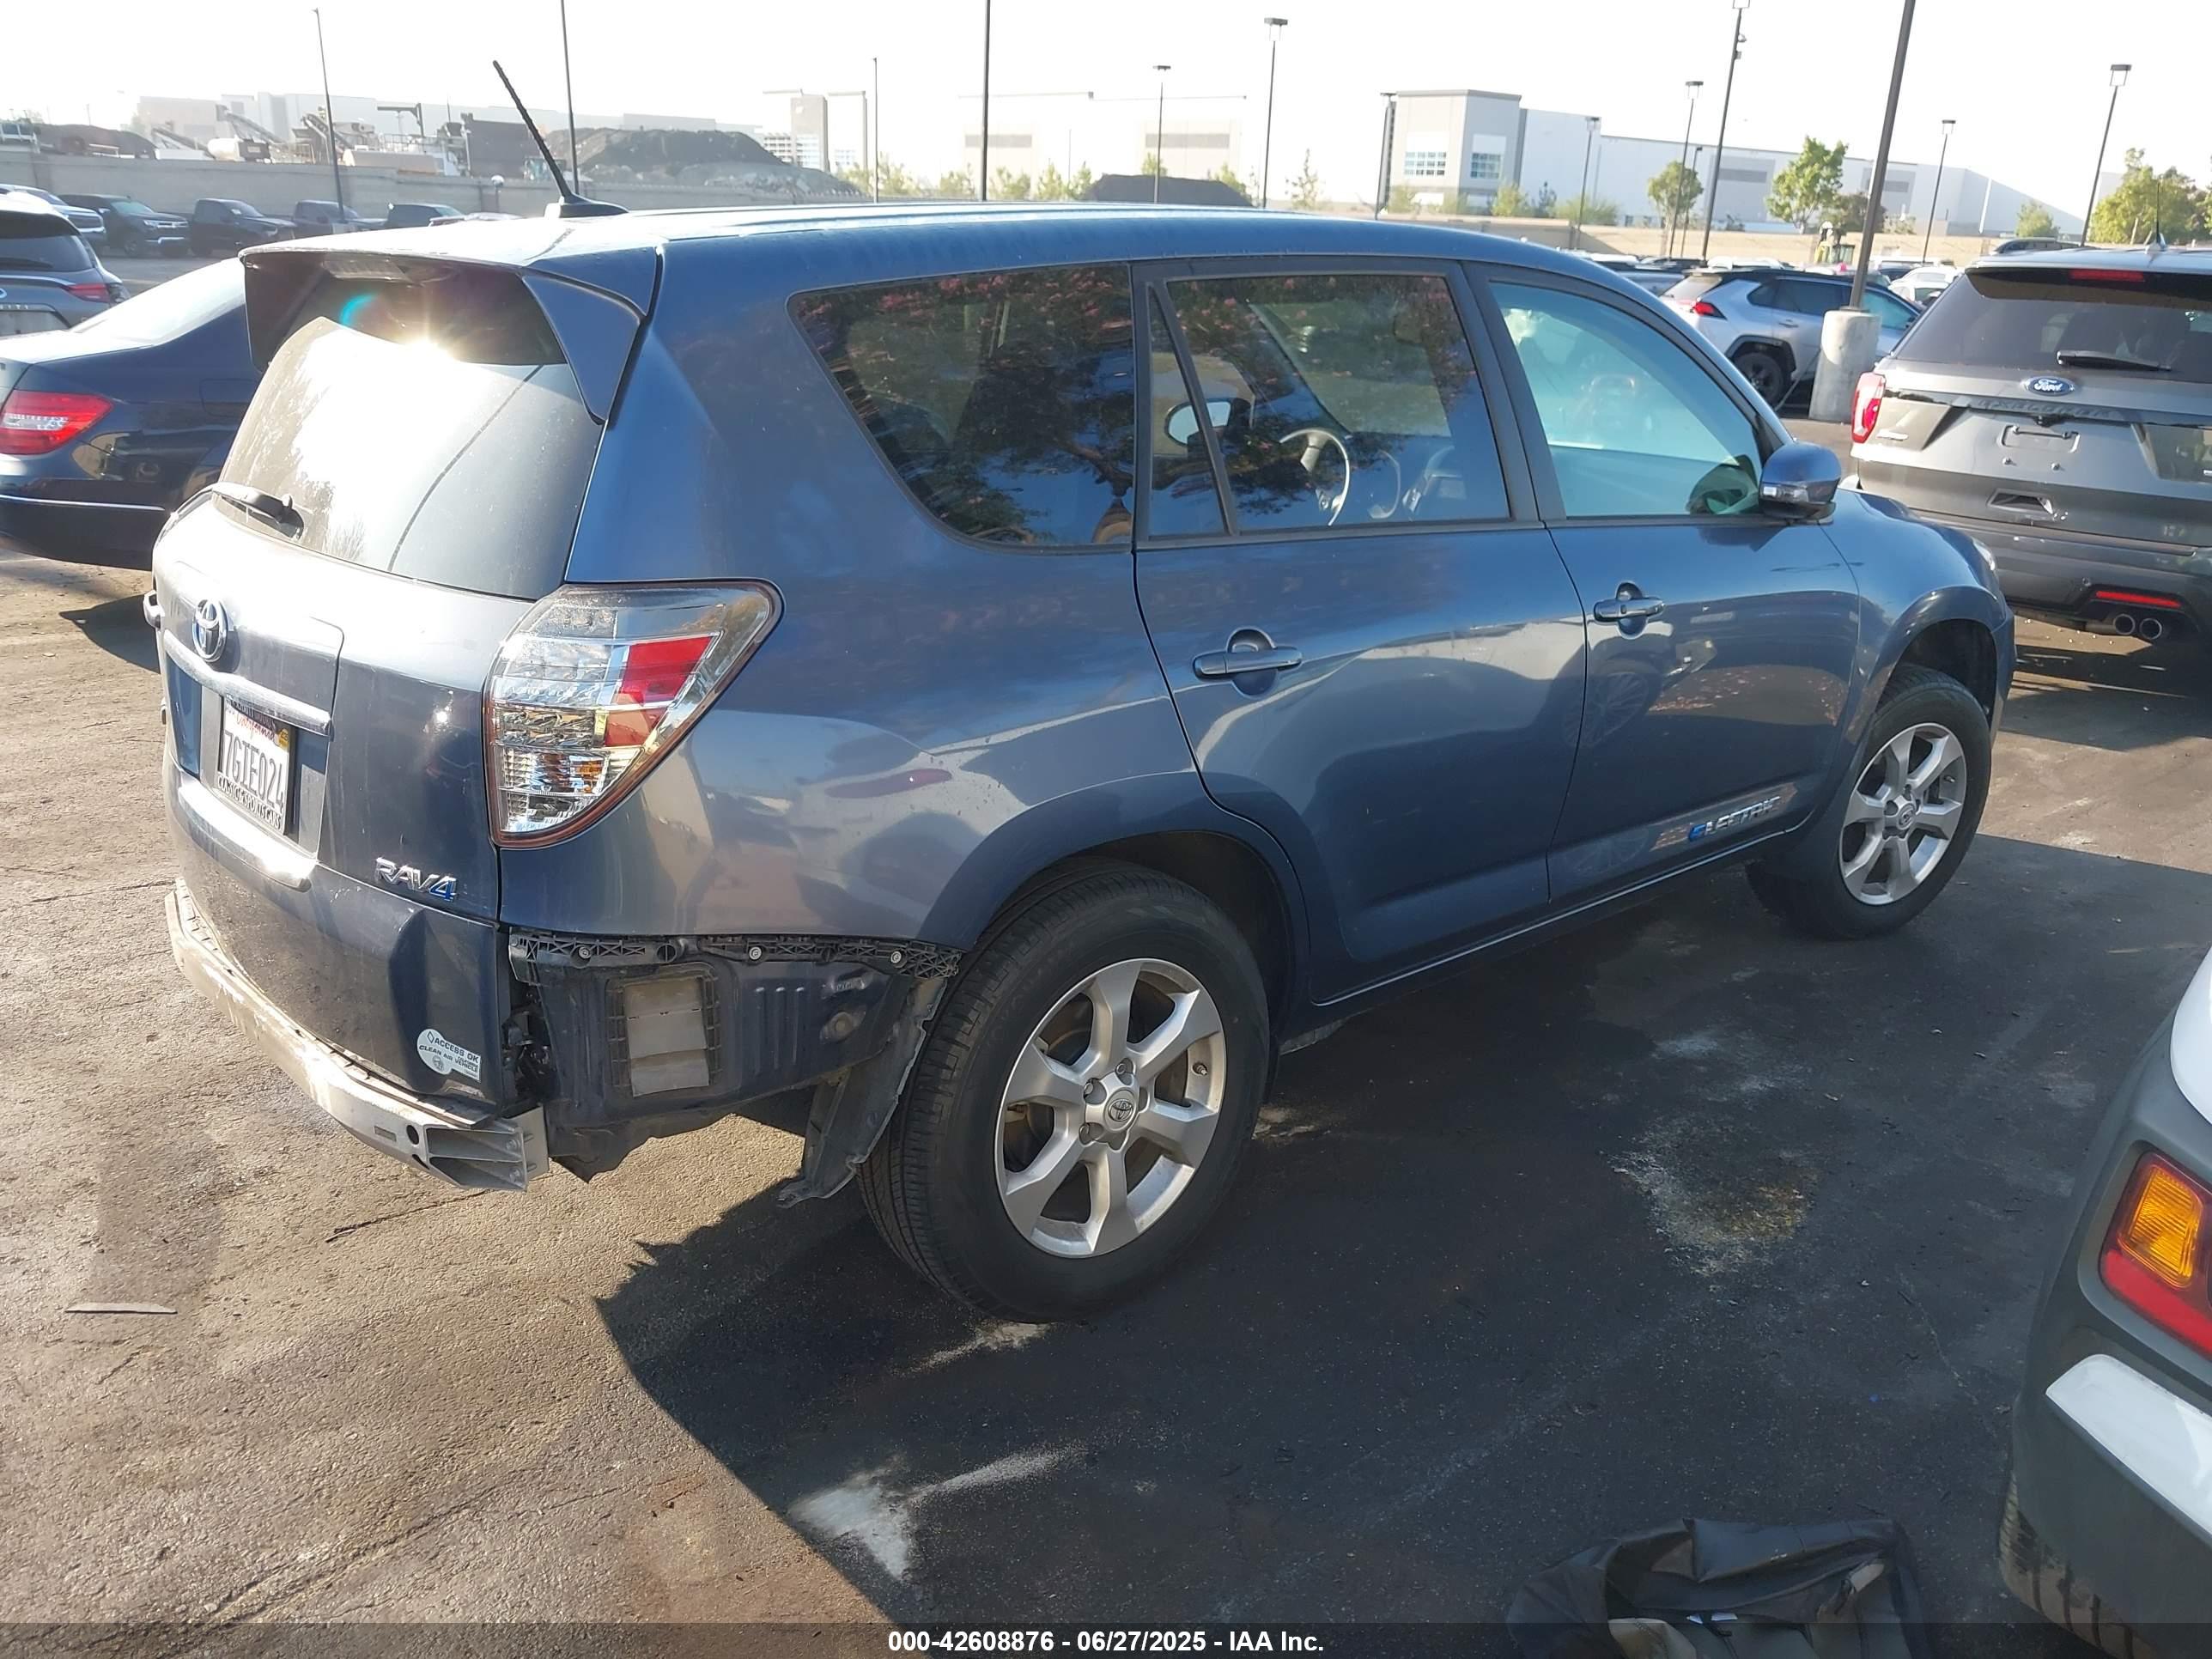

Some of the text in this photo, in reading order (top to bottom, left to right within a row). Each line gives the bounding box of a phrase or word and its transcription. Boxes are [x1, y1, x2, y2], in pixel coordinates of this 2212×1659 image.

[375, 857, 458, 902] RAV4
[419, 1044, 442, 1056] CLEAN
[454, 1058, 478, 1073] VEHICLE
[434, 1037, 479, 1064] ACCESS OK
